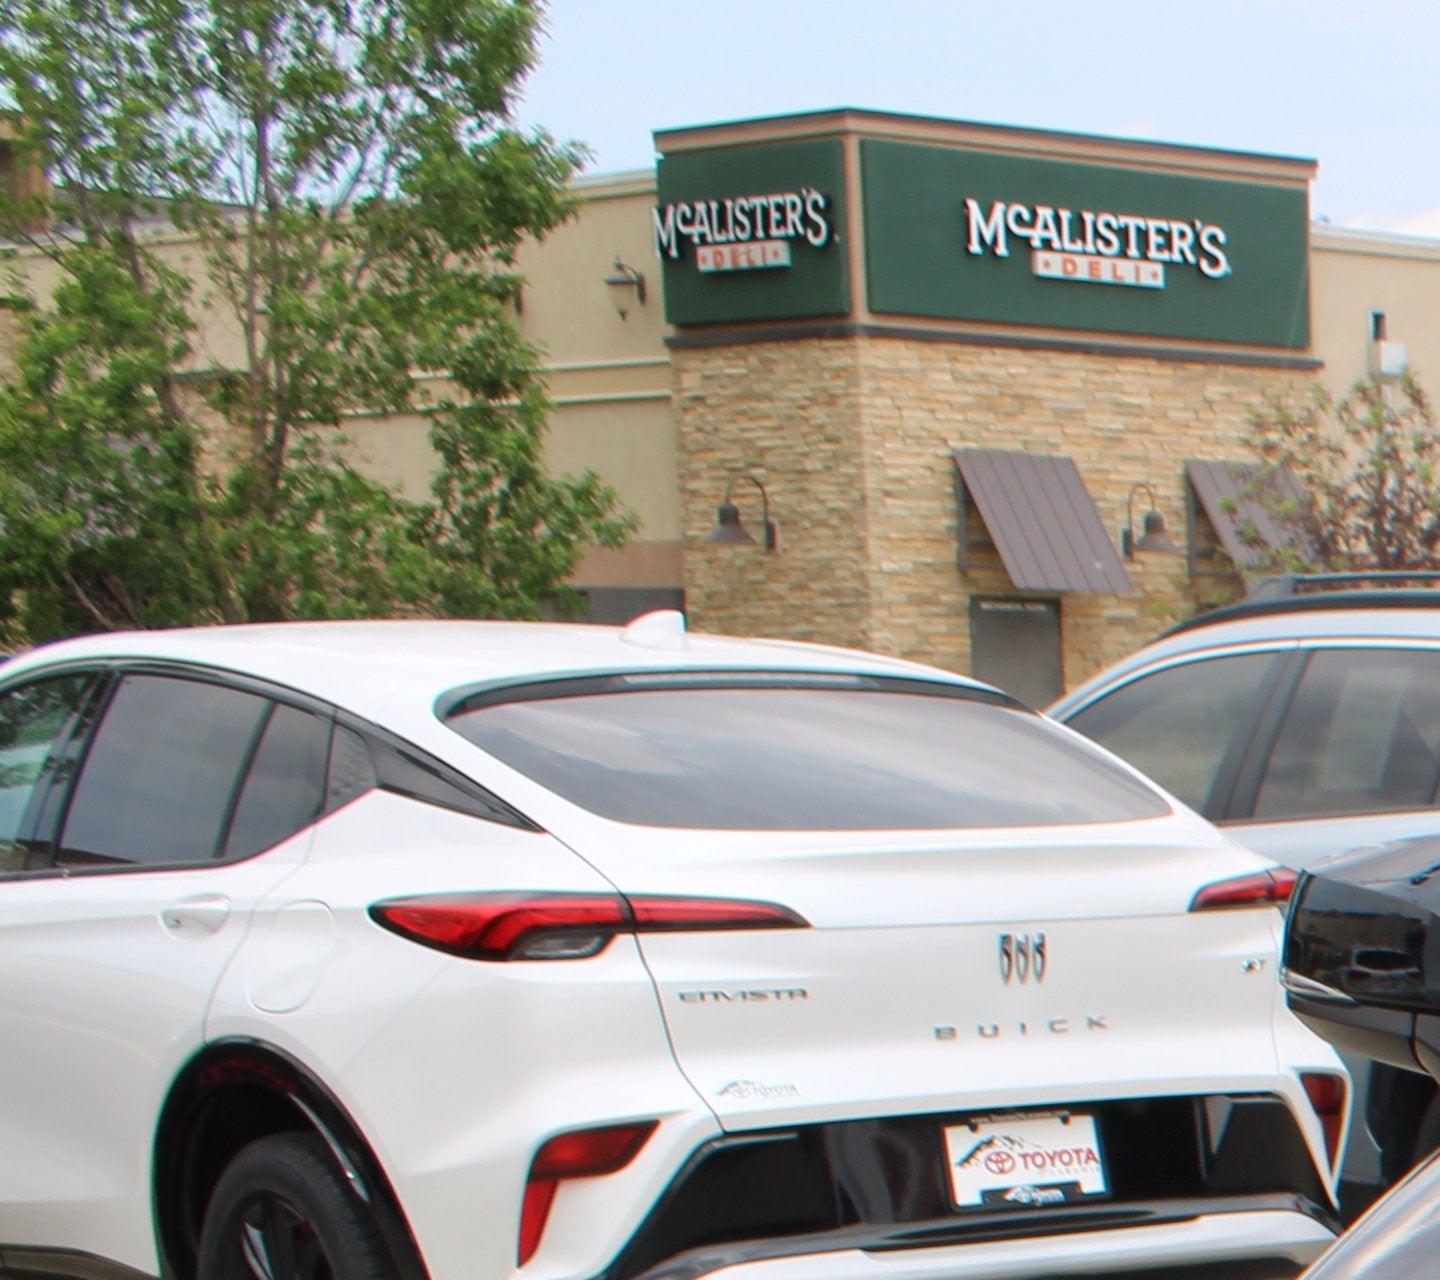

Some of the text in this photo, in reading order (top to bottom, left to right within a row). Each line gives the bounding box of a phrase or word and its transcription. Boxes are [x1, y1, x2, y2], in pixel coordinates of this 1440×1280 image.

[713, 245, 768, 269] DELI
[1062, 258, 1143, 283] DELI
[933, 1015, 1108, 1041] BUICK
[1018, 1146, 1099, 1170] TOYOTA
